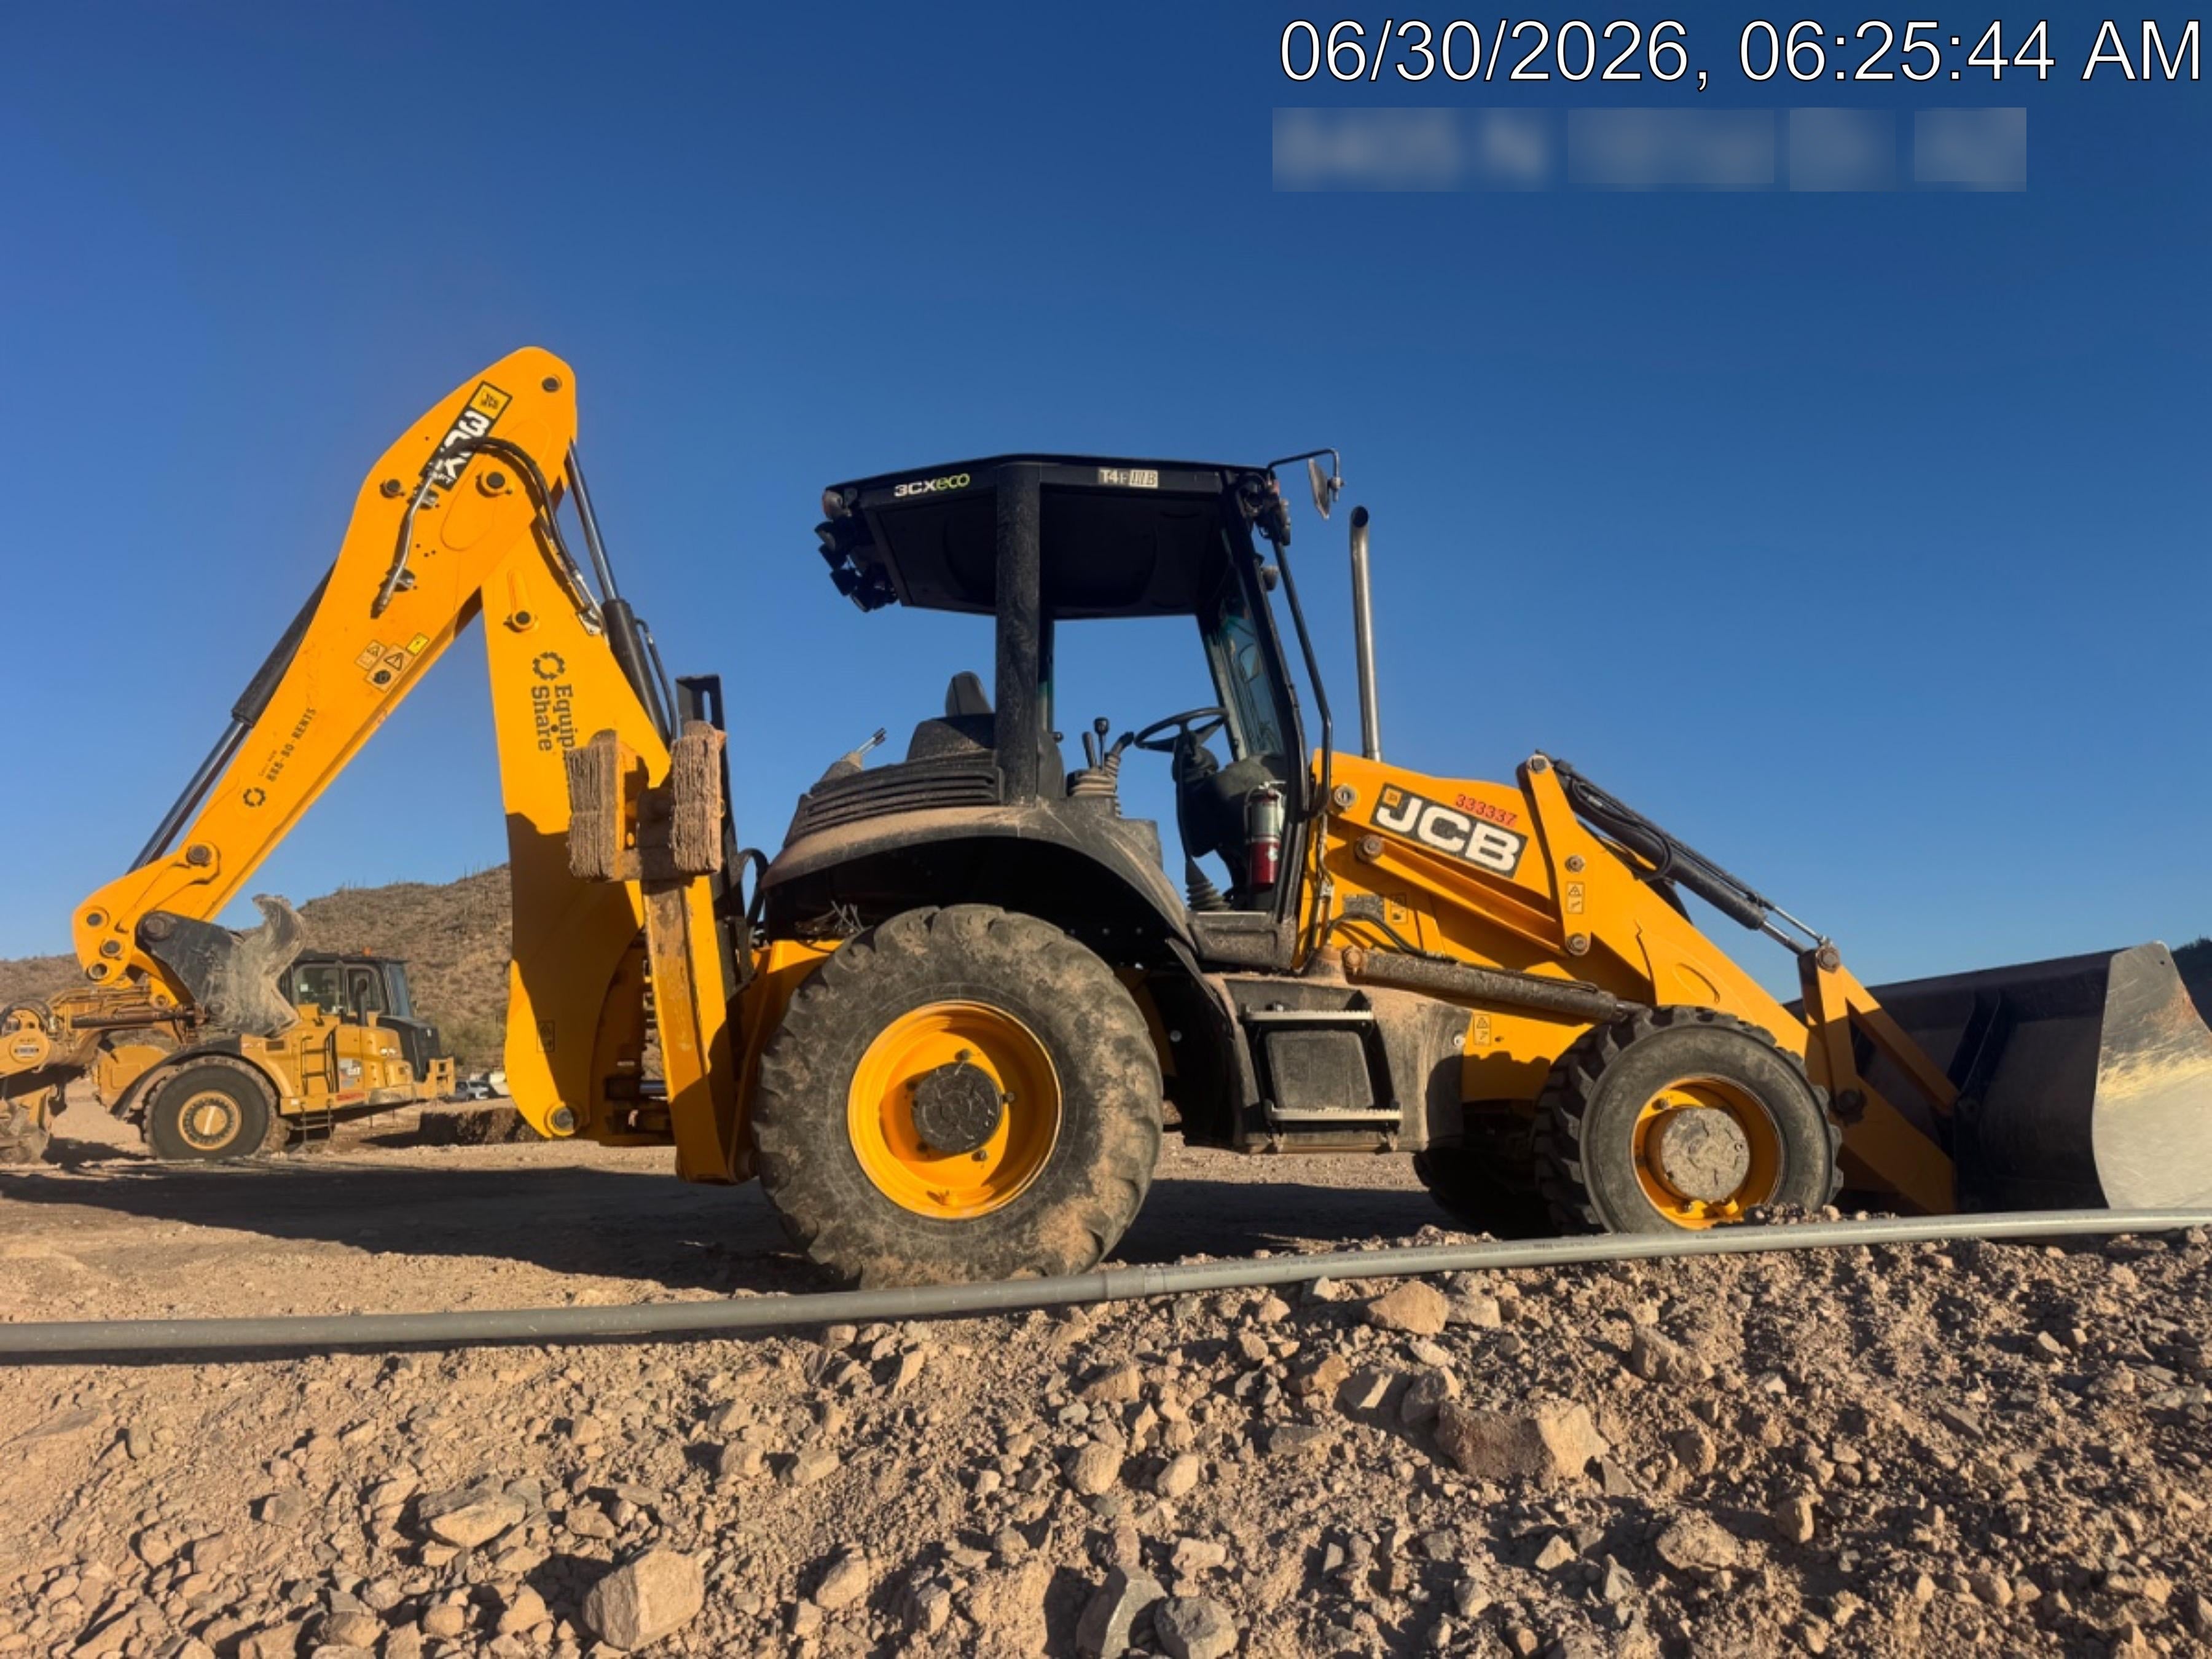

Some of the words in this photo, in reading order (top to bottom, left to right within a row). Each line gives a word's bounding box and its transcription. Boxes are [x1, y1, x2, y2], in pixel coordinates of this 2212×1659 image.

[531, 684, 553, 751] Share
[552, 684, 578, 748] Equip
[1376, 797, 1520, 871] JCB
[1456, 793, 1518, 827] 333337
